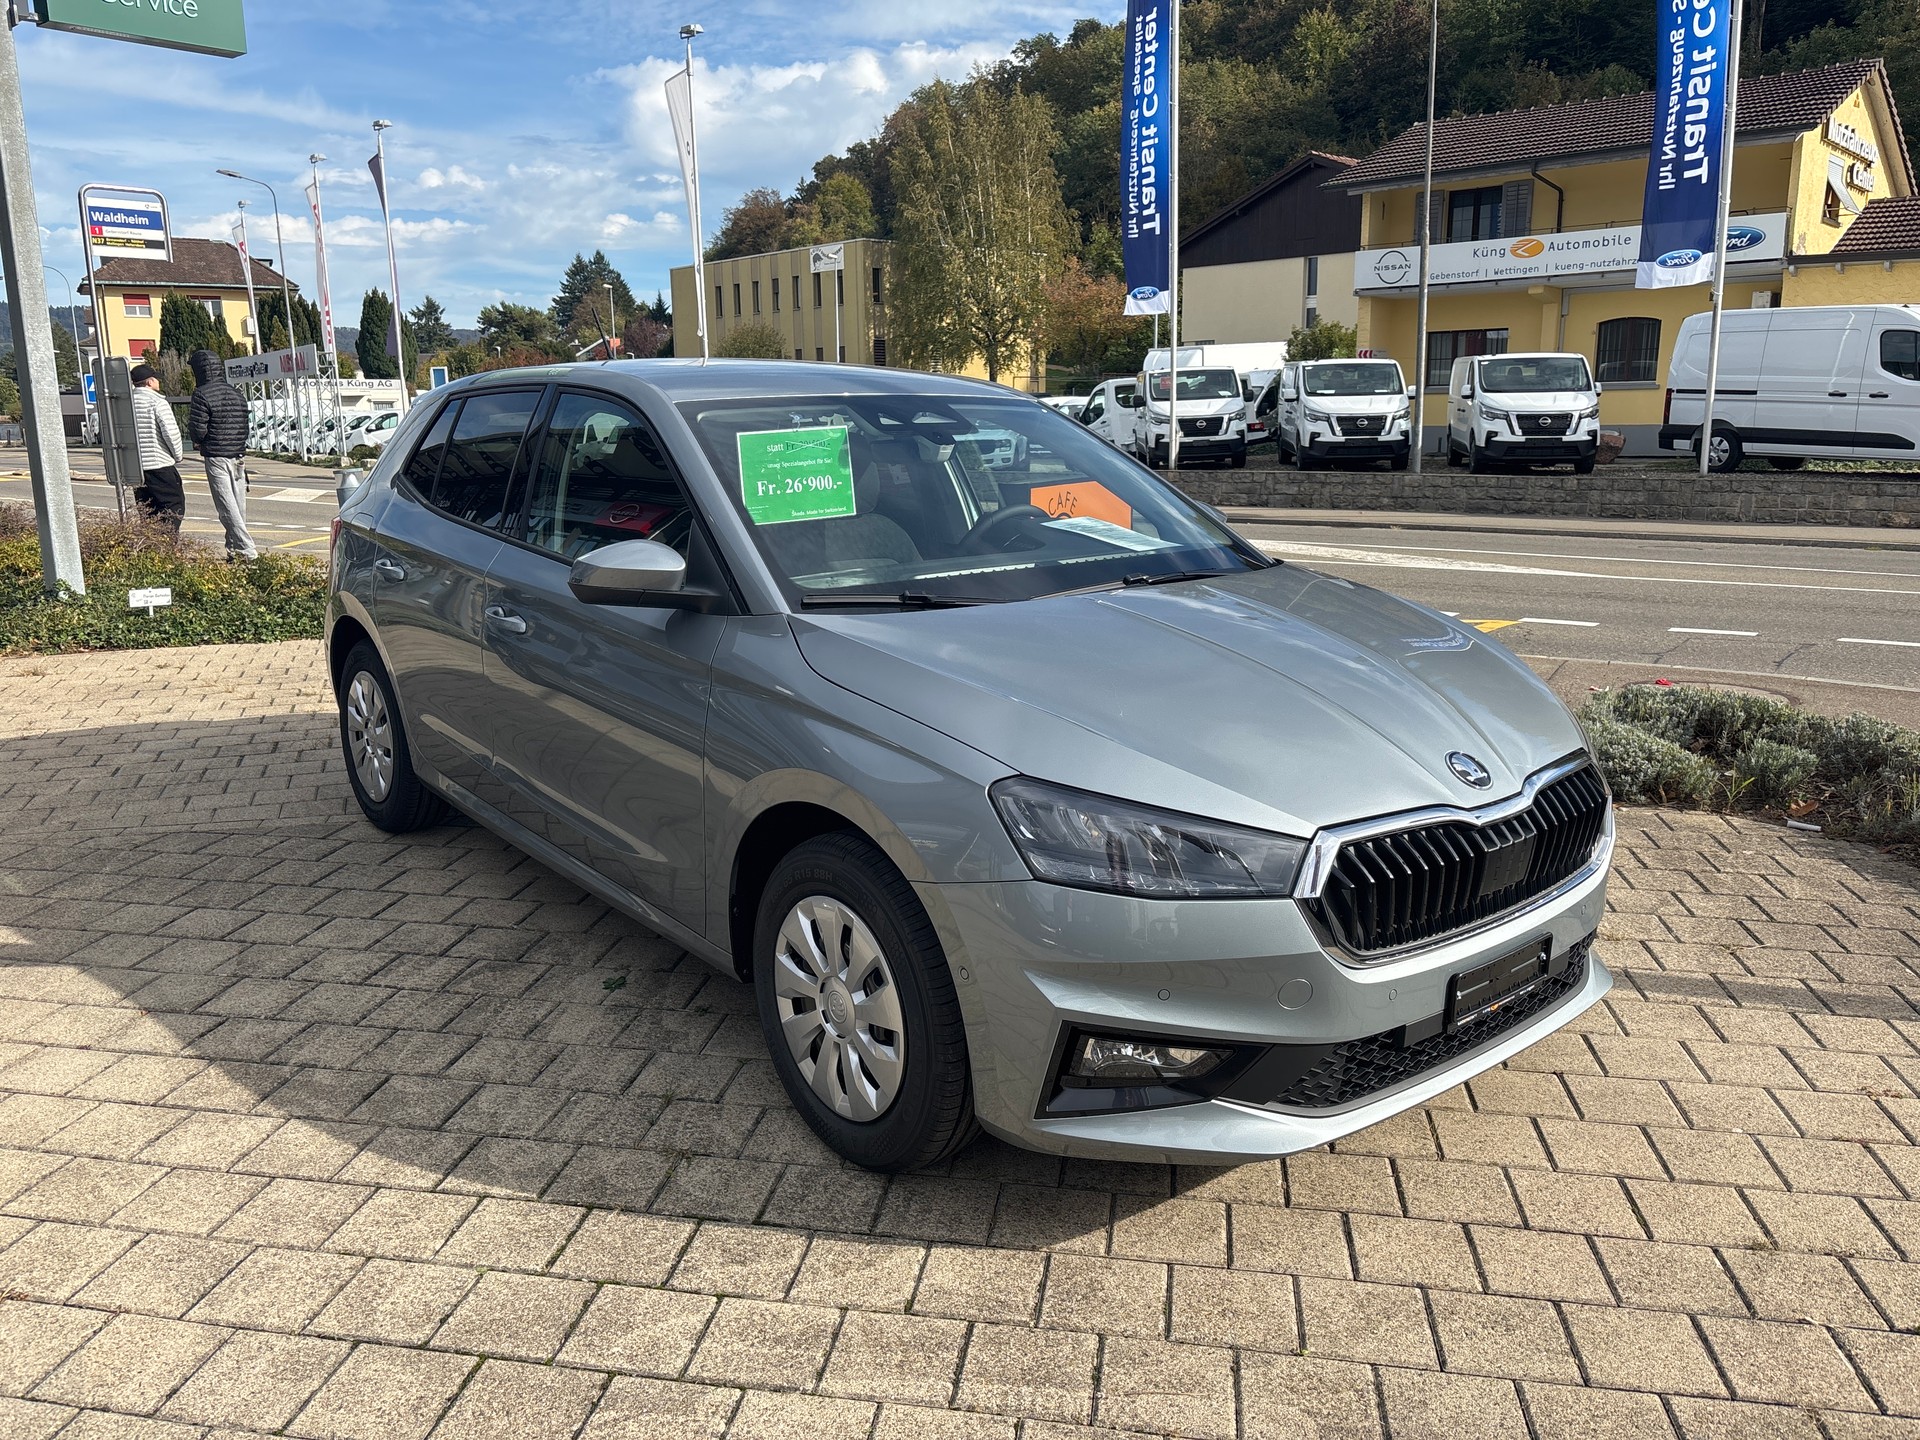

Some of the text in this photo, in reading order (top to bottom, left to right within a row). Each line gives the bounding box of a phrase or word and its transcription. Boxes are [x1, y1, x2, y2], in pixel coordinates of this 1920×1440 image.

[102, 0, 199, 18] vice
[90, 210, 149, 225] Waldheim
[94, 227, 99, 235] 1
[92, 237, 105, 245] N37
[1472, 234, 1632, 259] Küng Automobile
[1373, 263, 1412, 272] NISSAN
[1429, 269, 1480, 281] Gebenstorf
[1493, 265, 1540, 276] Wettingen
[1554, 257, 1639, 271] kueng-nutzfahrz
[347, 379, 374, 388] Küng
[766, 443, 784, 452] statt
[757, 480, 781, 497] Fr.
[1048, 491, 1078, 516] CAFE
